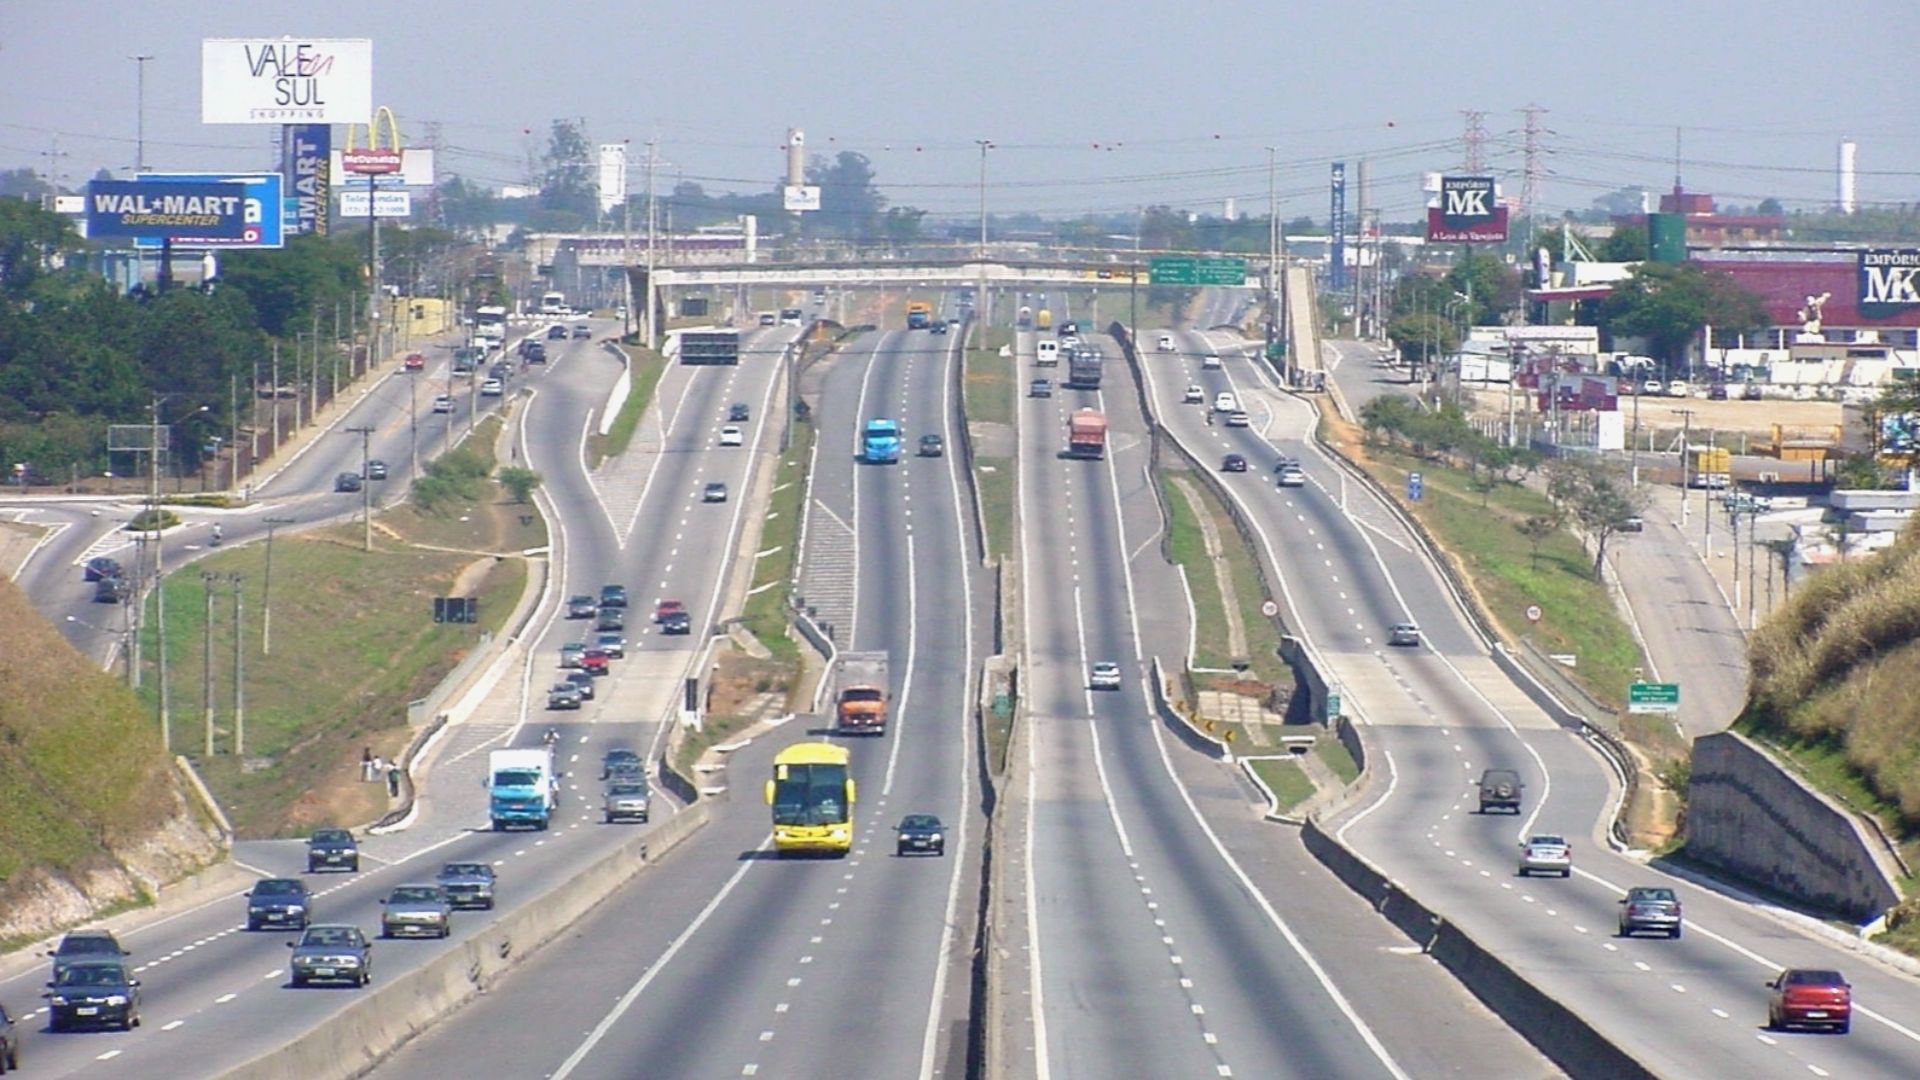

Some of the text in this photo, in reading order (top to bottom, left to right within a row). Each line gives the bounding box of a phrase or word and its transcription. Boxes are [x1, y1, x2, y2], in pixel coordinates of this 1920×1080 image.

[244, 44, 314, 77] VALE
[274, 77, 326, 106] SUL
[248, 110, 326, 119] SHOPPING
[1445, 190, 1490, 215] MK
[121, 214, 220, 226] SUPERCENTER
[1863, 266, 1920, 303] MK
